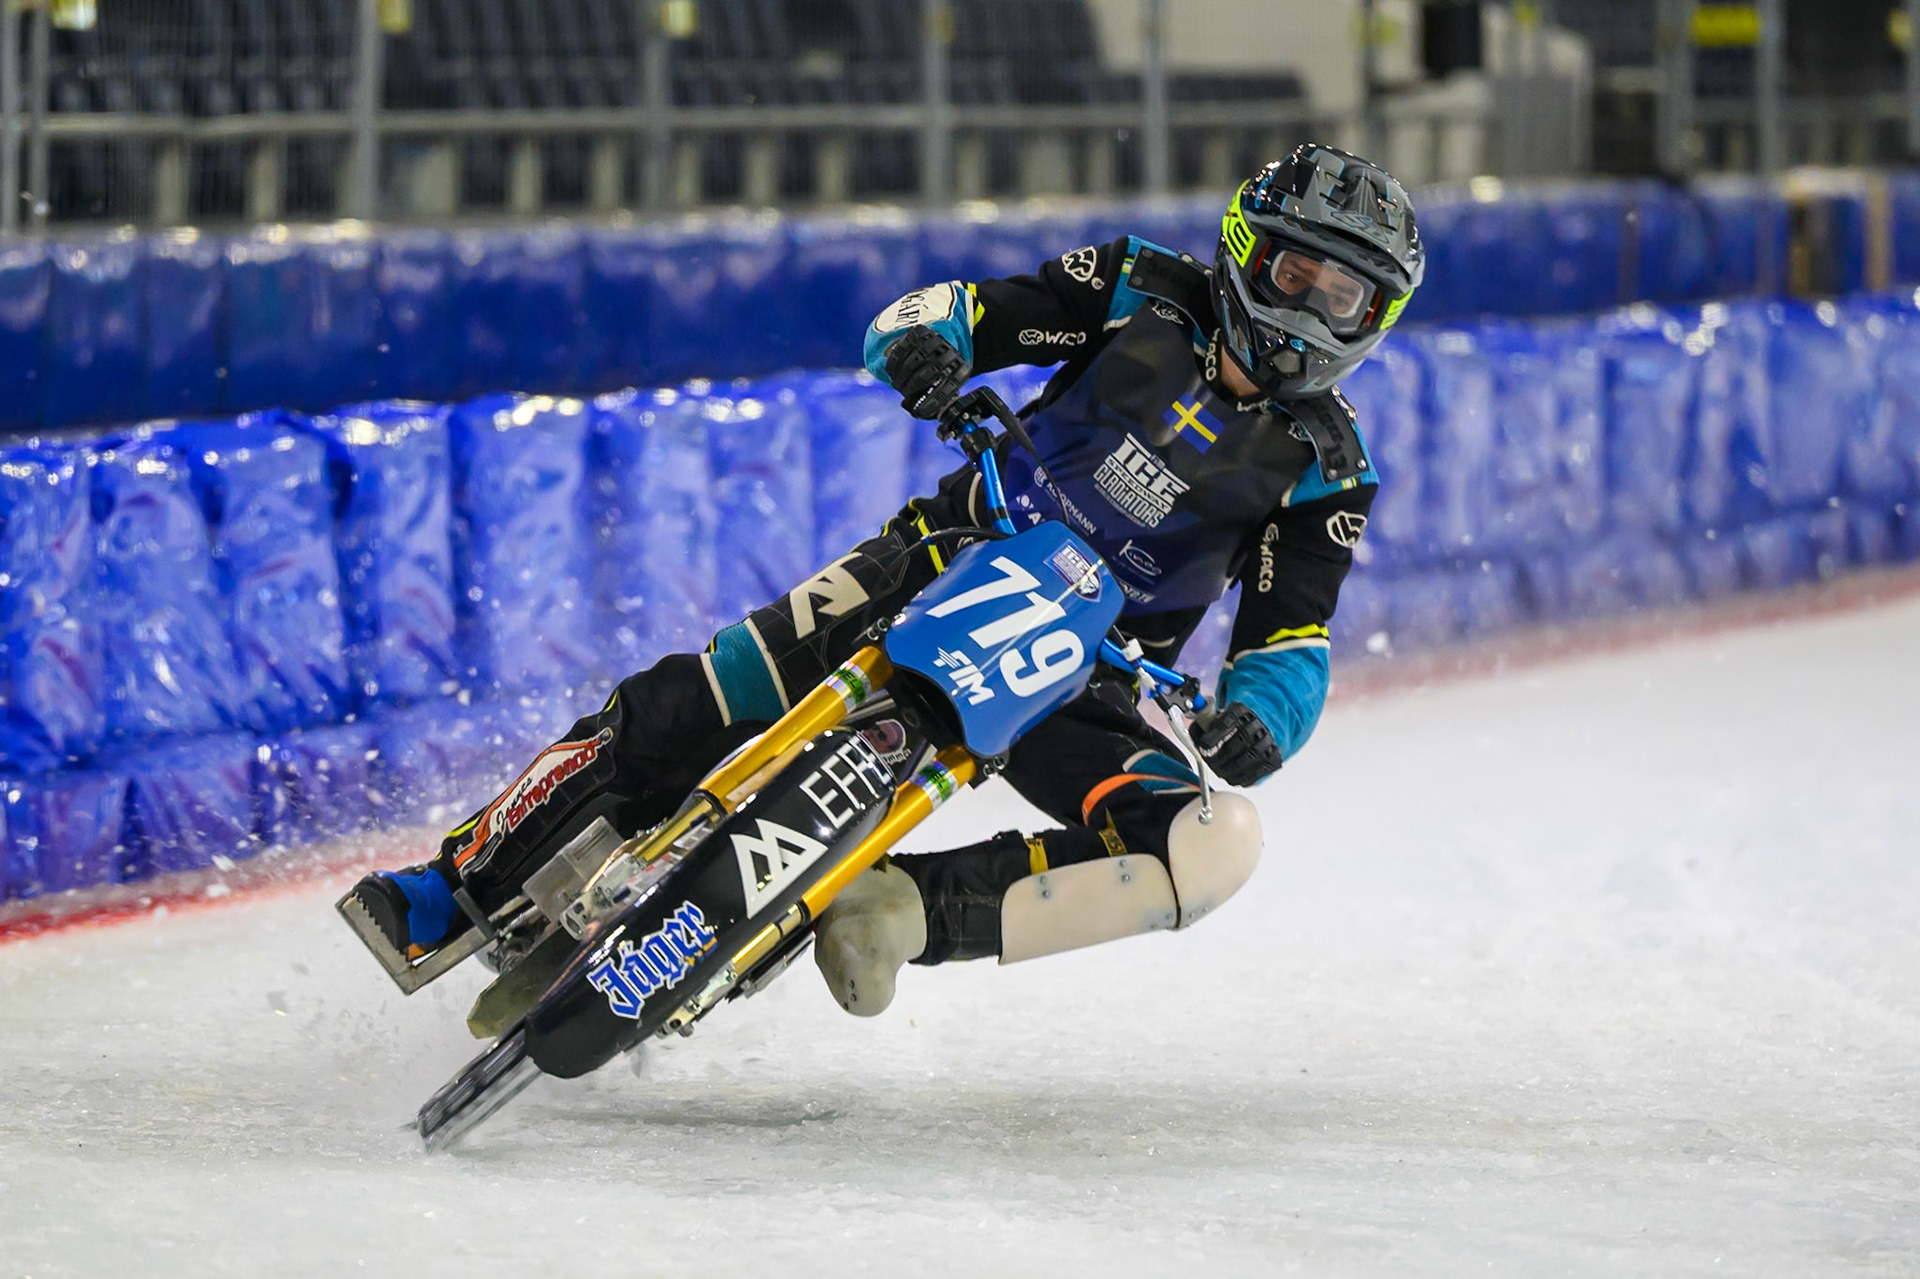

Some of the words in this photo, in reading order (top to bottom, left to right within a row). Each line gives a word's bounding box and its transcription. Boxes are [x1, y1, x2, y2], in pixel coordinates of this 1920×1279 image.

[1106, 457, 1171, 511] SPEEDWAY
[1112, 437, 1186, 507] ICE
[925, 556, 1085, 698] 719
[933, 647, 996, 706] FIM
[586, 900, 718, 1020] Jäger
